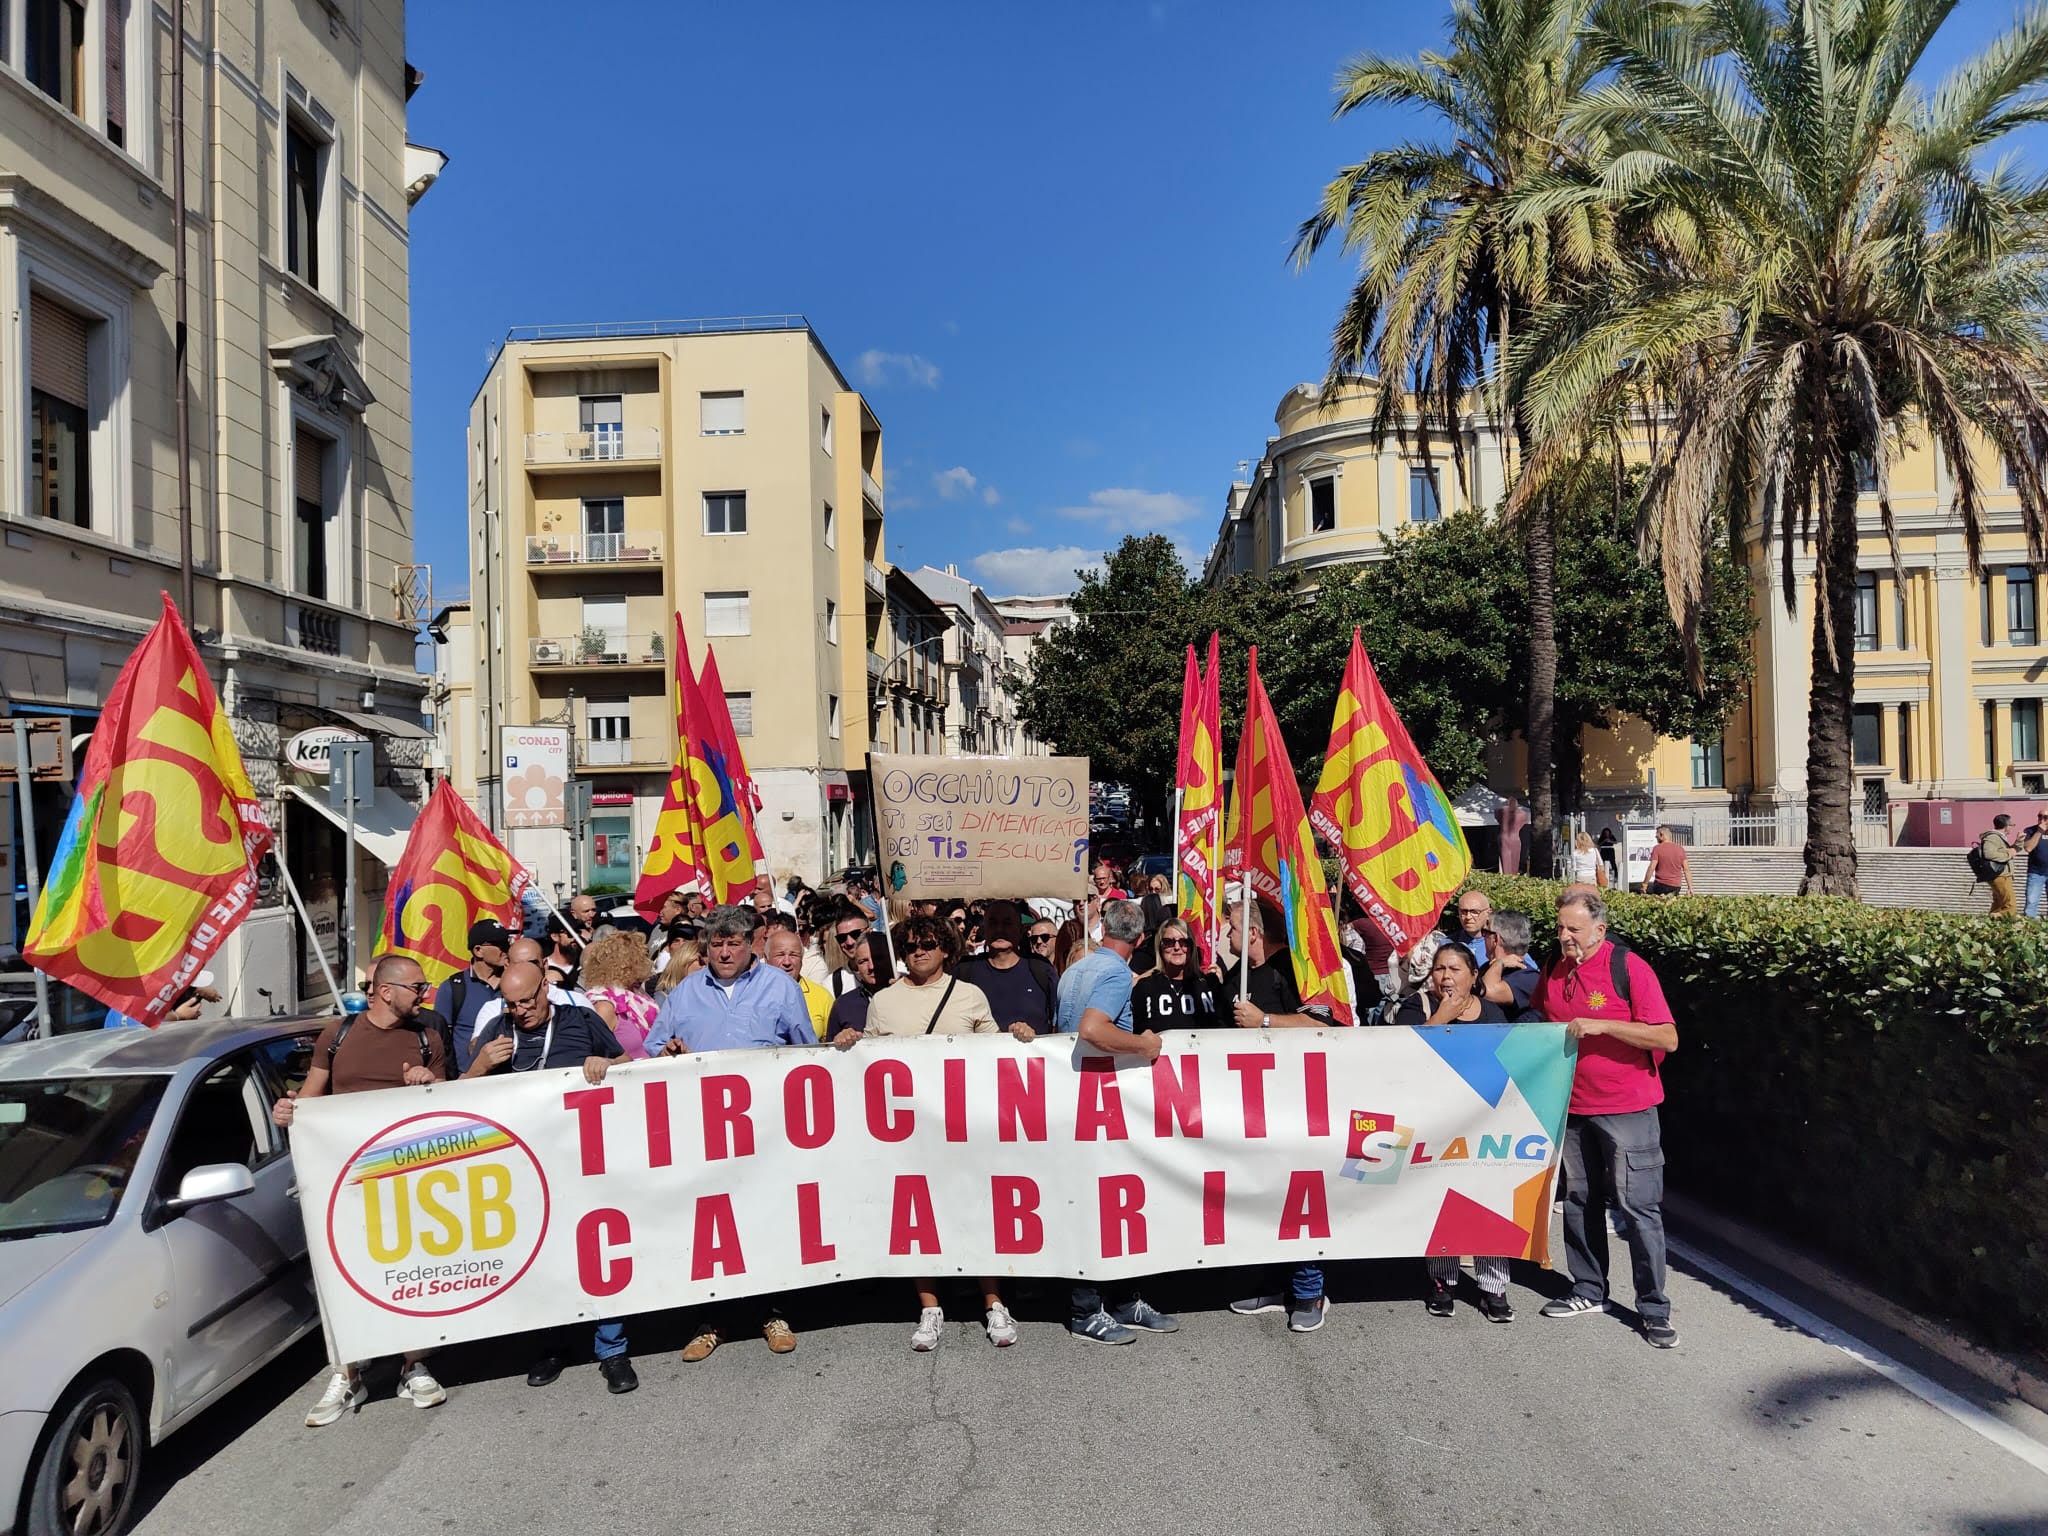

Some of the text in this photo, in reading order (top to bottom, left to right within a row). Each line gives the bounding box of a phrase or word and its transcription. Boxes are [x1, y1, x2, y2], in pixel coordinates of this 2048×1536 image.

[295, 740, 331, 760] ken
[518, 736, 560, 746] CONAD
[1314, 687, 1467, 916] USB
[1353, 883, 1374, 904] DI
[1369, 902, 1409, 947] BASE
[563, 1052, 1331, 1176] TIROCINANTI
[1355, 1119, 1377, 1132] USB
[392, 1129, 479, 1166] CALABRIA
[362, 1163, 517, 1265] USB
[576, 1170, 1331, 1297] CALABRIA
[384, 1258, 505, 1286] Federazione
[391, 1273, 501, 1301] del Sociale
